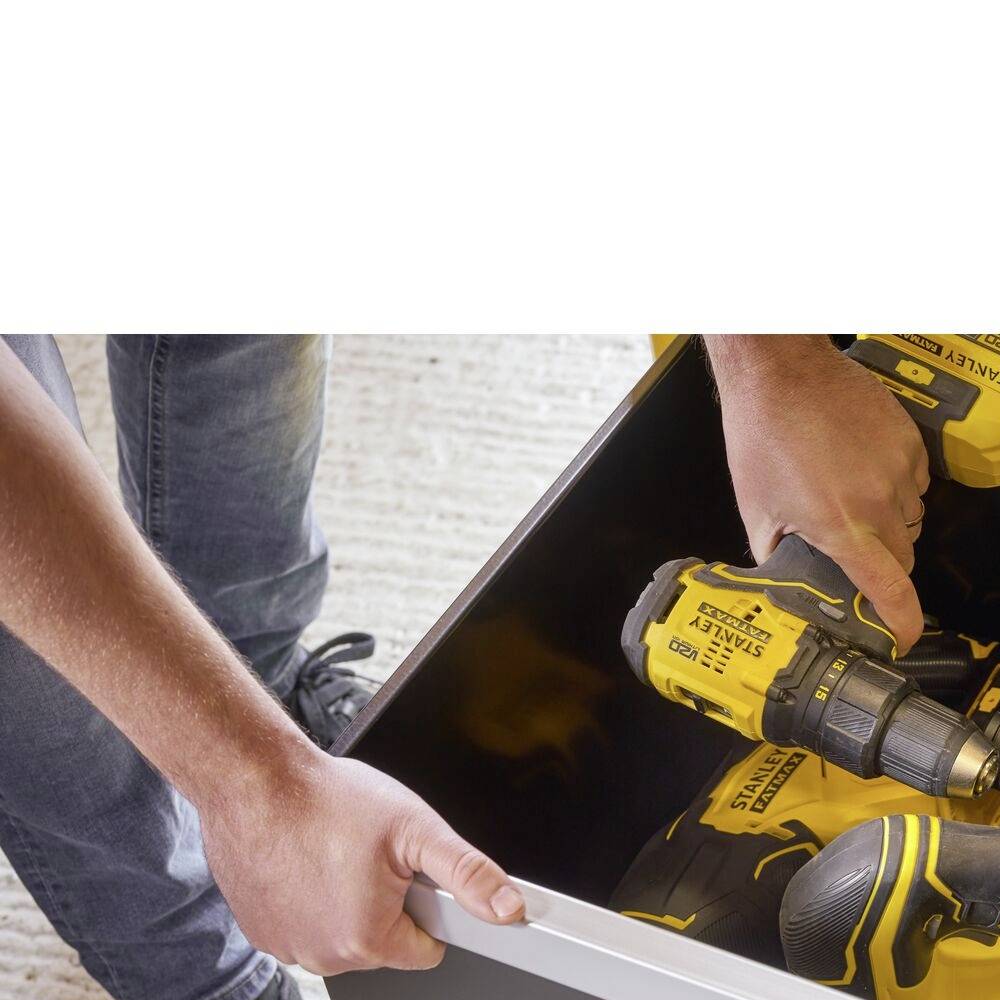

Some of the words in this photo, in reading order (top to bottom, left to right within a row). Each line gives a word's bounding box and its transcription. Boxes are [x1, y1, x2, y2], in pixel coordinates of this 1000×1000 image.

[898, 334, 938, 353] FATM
[689, 616, 764, 658] STANLEY
[702, 604, 773, 644] FATMAX
[668, 639, 699, 662] V20
[832, 658, 848, 672] 13
[815, 685, 830, 701] 15
[730, 749, 787, 811] STANLEY
[753, 754, 804, 811] FATMAX
